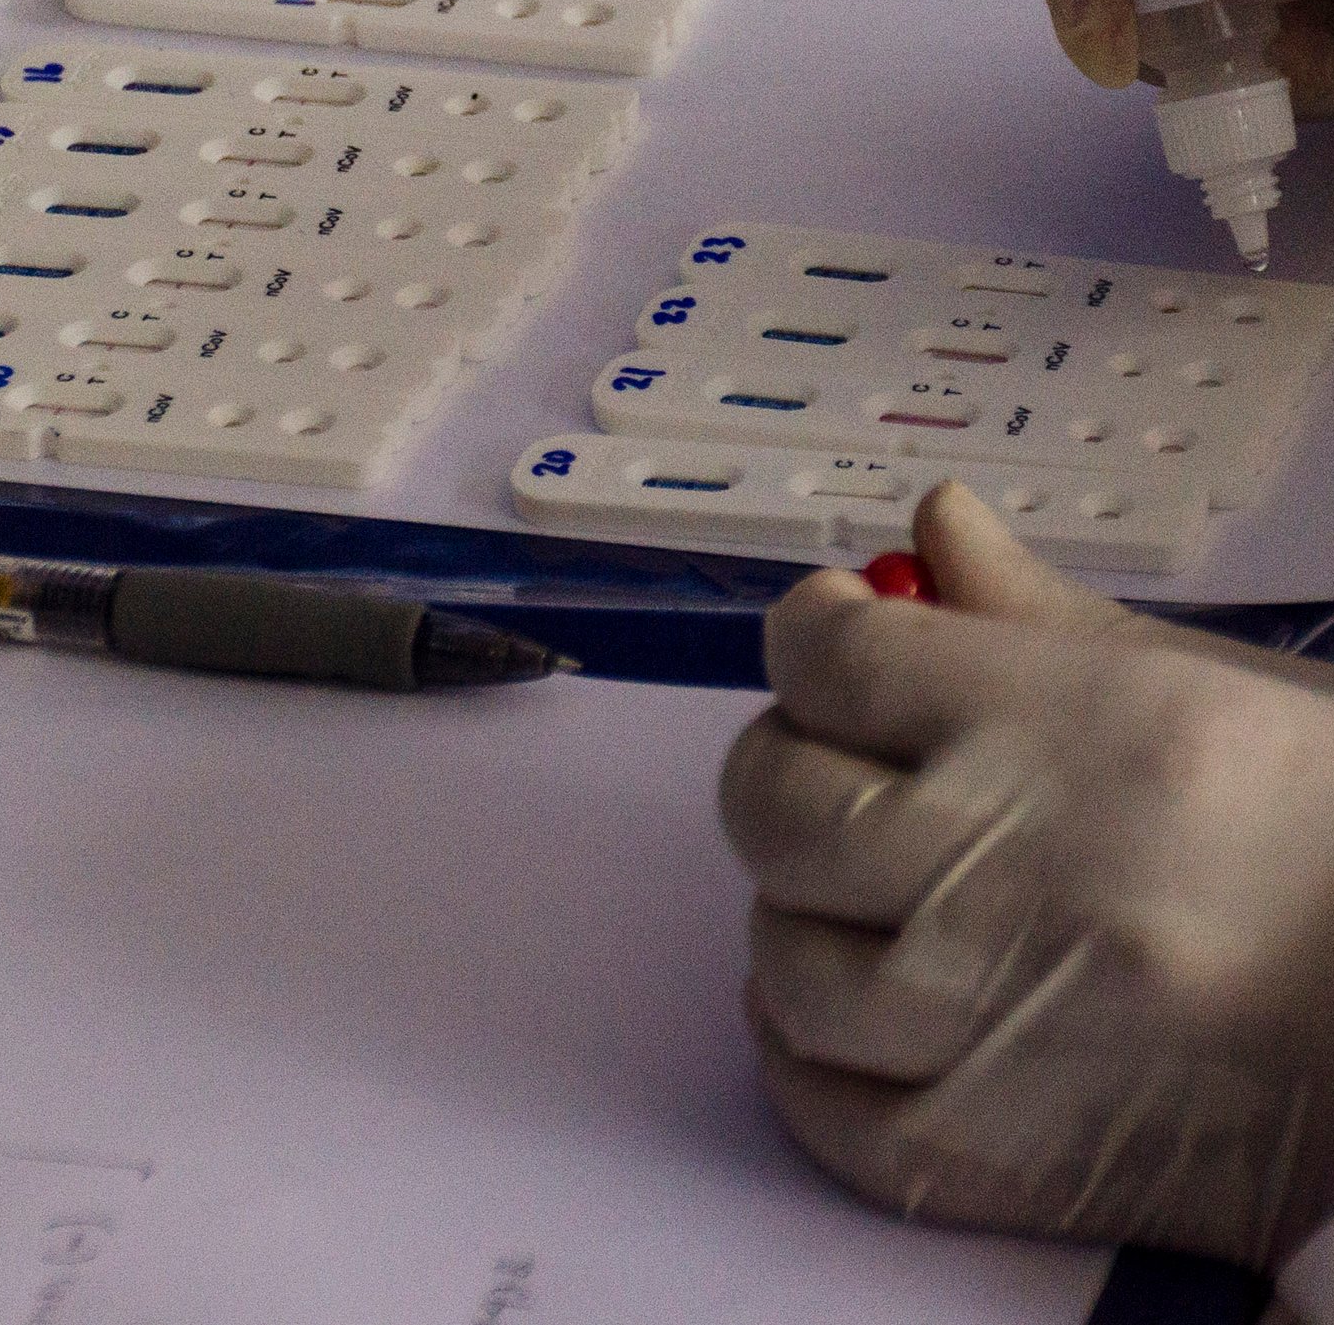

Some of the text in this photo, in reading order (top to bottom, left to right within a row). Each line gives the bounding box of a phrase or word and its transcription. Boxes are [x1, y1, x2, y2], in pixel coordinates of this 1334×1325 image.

[25, 64, 63, 82] 16
[693, 237, 745, 263] 23
[652, 297, 696, 325] 22
[612, 367, 665, 391] 21
[532, 450, 575, 476] 20
